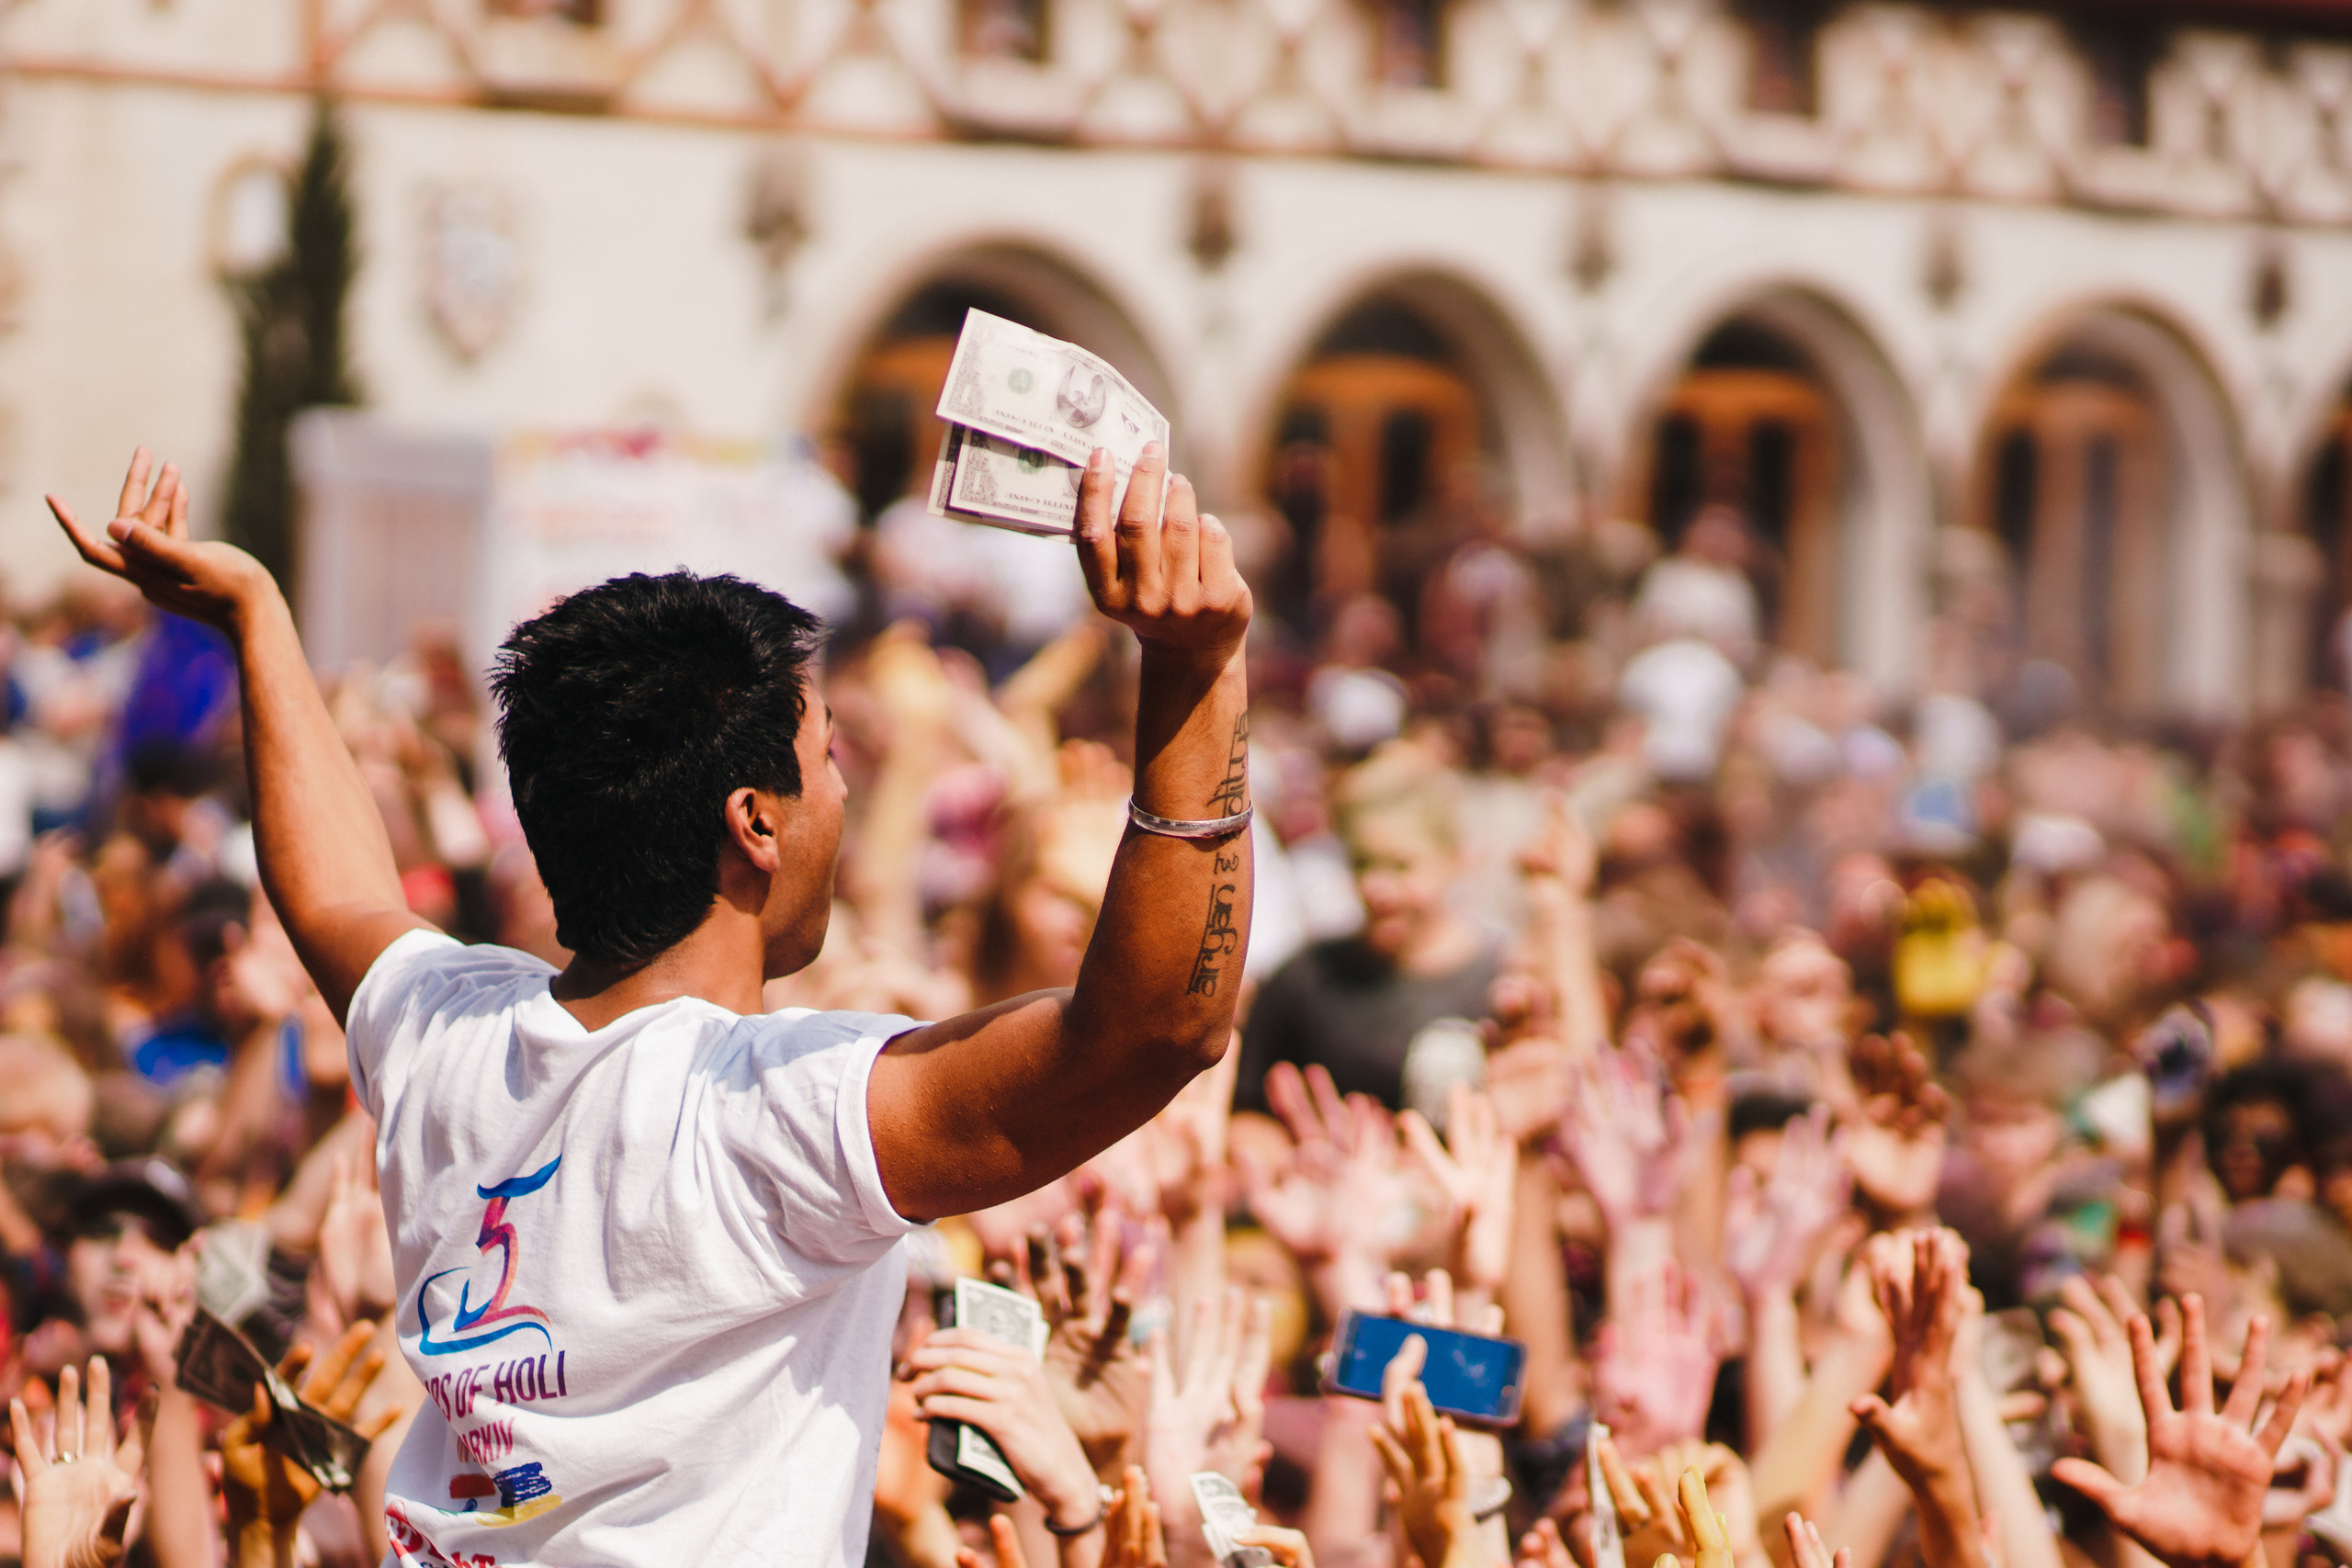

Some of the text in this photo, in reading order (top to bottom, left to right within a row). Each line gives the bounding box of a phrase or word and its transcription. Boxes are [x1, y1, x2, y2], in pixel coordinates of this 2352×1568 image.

[1187, 884, 1238, 998] aryan
[455, 1364, 491, 1418] OF
[493, 1350, 567, 1405] HOLI
